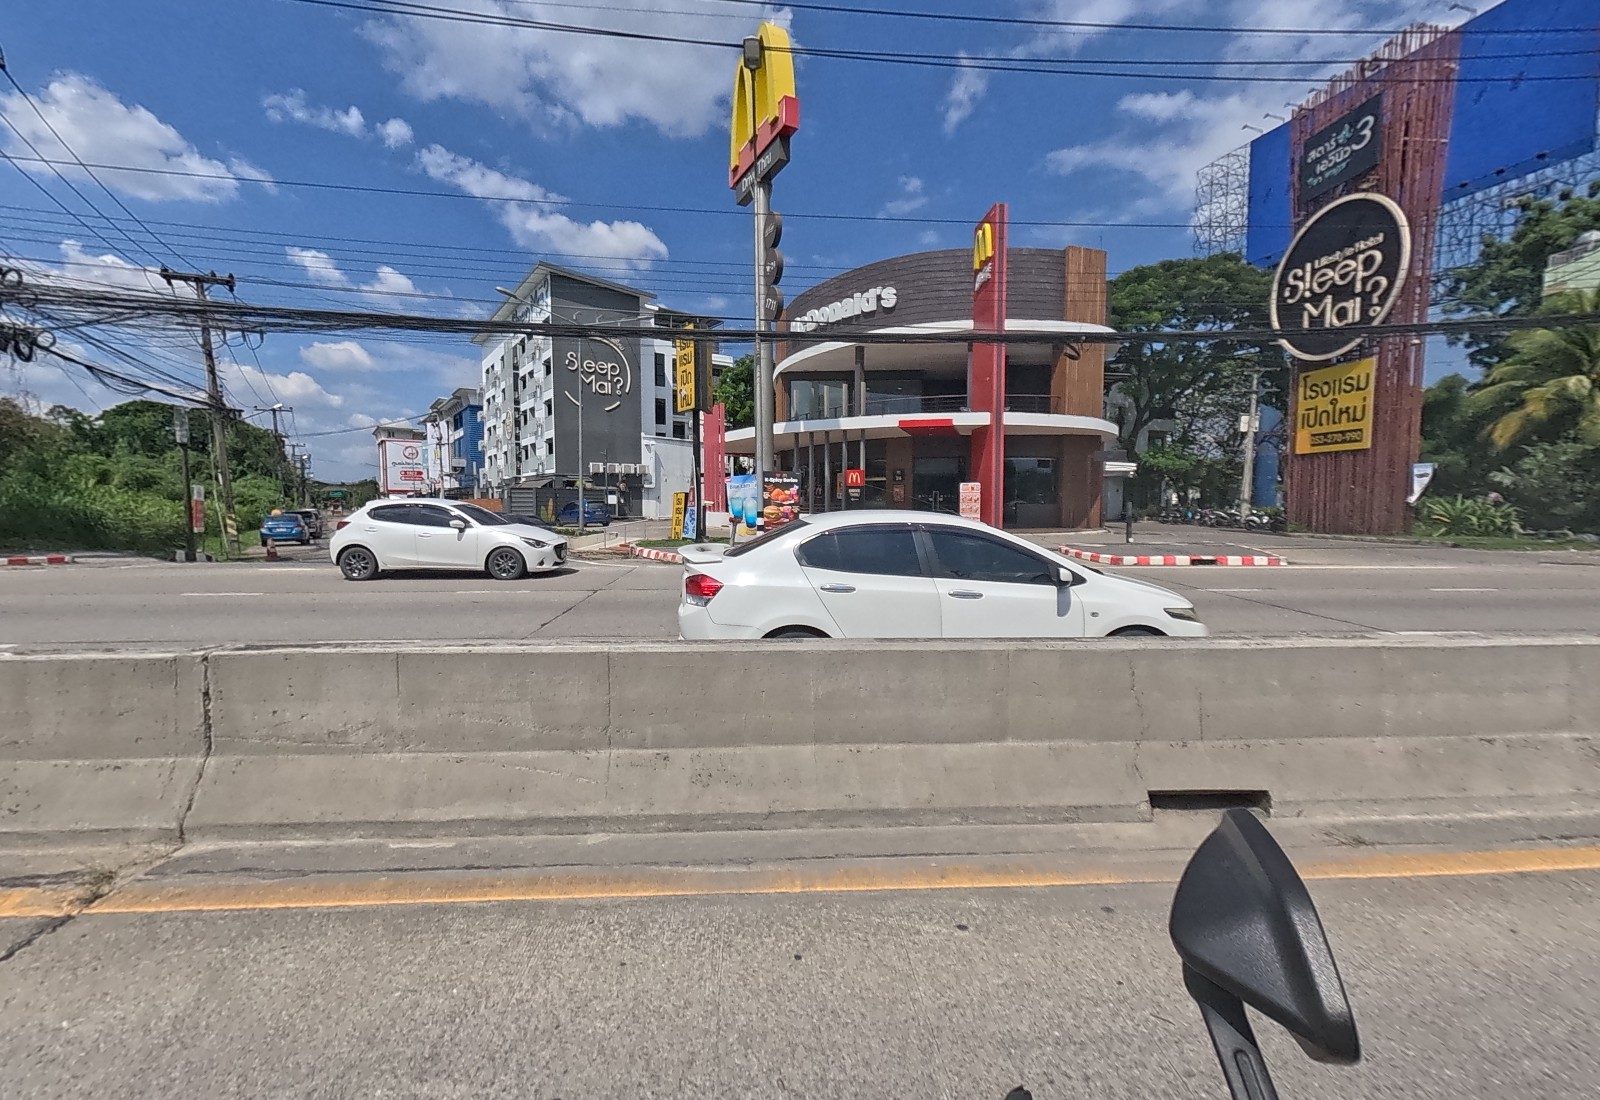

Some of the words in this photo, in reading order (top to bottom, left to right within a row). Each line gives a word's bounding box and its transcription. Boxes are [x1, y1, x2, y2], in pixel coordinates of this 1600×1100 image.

[1351, 115, 1374, 150] 3
[1302, 372, 1369, 400] โรงแรม
[1301, 396, 1367, 429] เปิดใหม่
